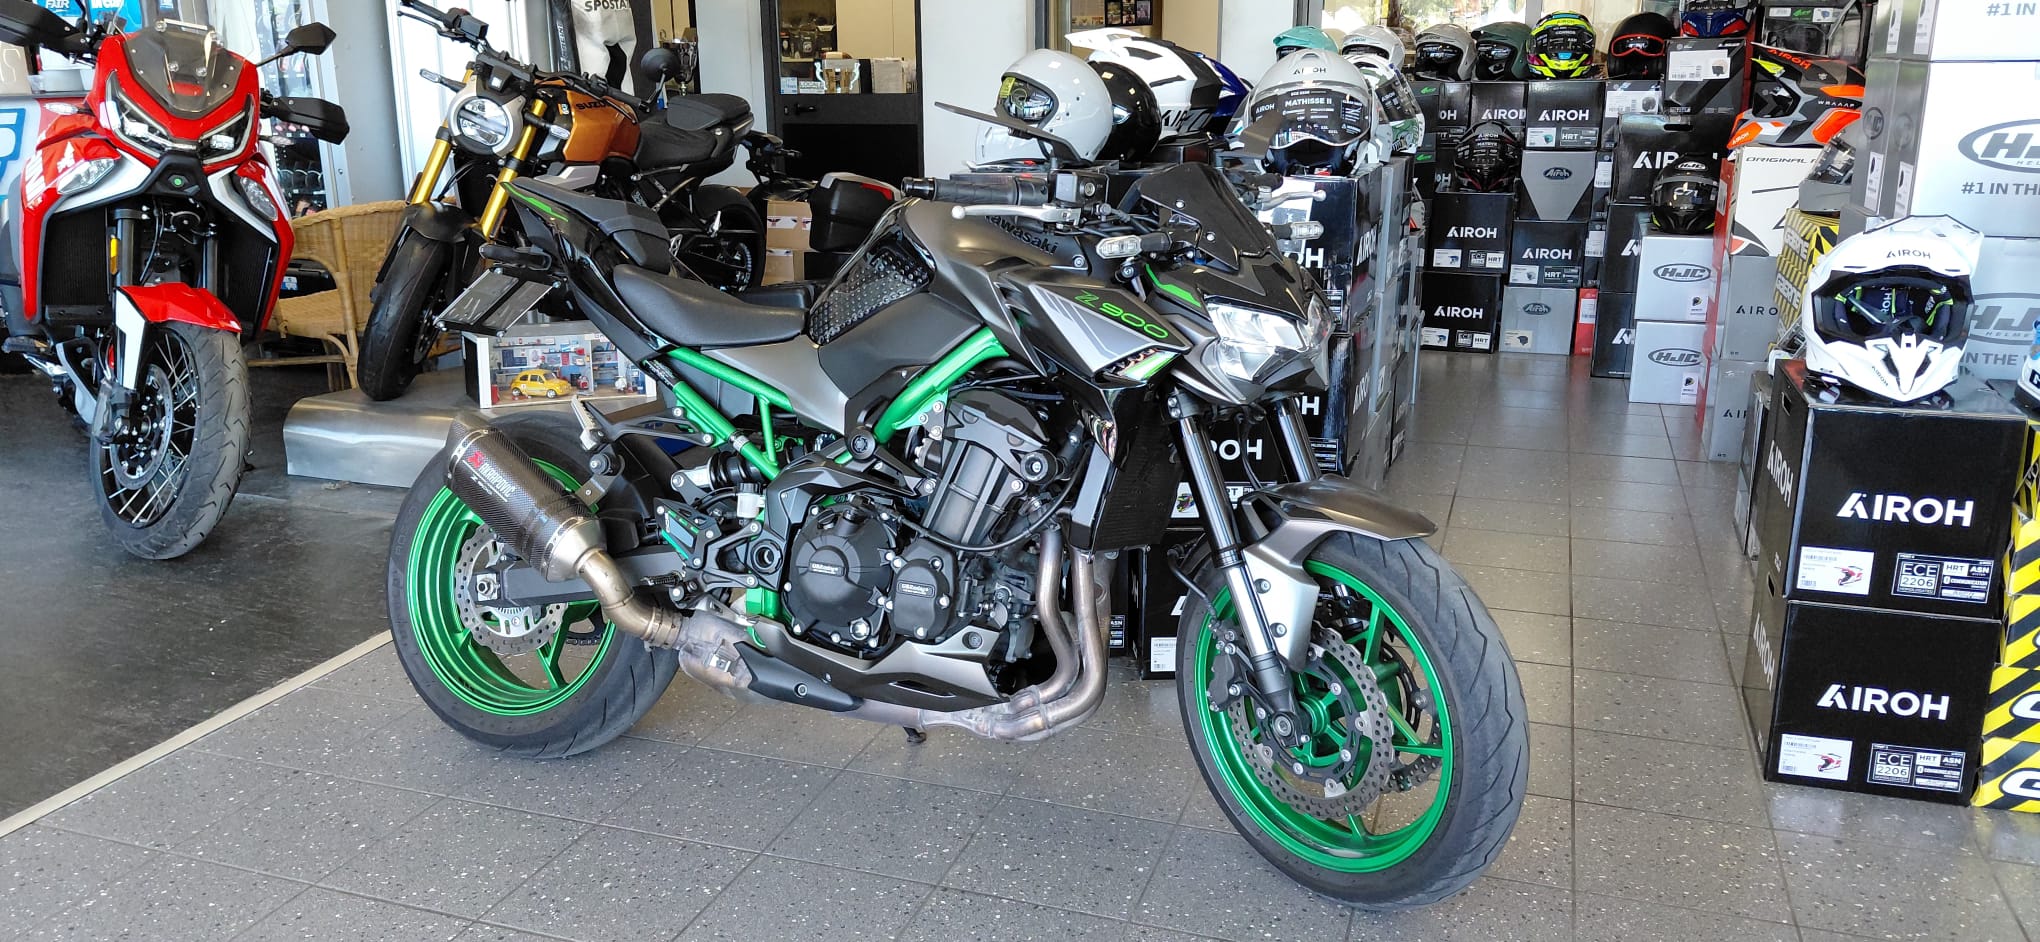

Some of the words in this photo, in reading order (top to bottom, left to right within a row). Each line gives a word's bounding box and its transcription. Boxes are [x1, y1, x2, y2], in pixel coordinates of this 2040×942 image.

[1987, 3, 2010, 16] #1
[2016, 3, 2037, 16] IN
[1767, 48, 1812, 70] AIROH
[1293, 67, 1327, 75] AIOH
[1255, 103, 1275, 114] AIROH
[1285, 98, 1325, 108] MATHISSE
[1538, 109, 1590, 121] AIROH
[1961, 182, 1985, 195] #1
[1989, 182, 2008, 195] IN
[1446, 226, 1497, 239] AIROH
[1522, 248, 1572, 260] AIROH
[1886, 249, 1931, 259] AIROH
[1660, 267, 1706, 279] HJC
[1434, 306, 1484, 319] AIROH
[1655, 352, 1701, 363] HJC
[1981, 353, 2018, 366] THE
[1767, 440, 1794, 508] AIROH
[1836, 492, 1974, 527] AIROH
[1902, 563, 1937, 577] ECE
[1902, 577, 1934, 587] 2206
[1753, 613, 1776, 693] AIROH
[1817, 683, 1950, 721] AIROH
[1876, 752, 1911, 766] ECE
[1877, 766, 1908, 776] 2206
